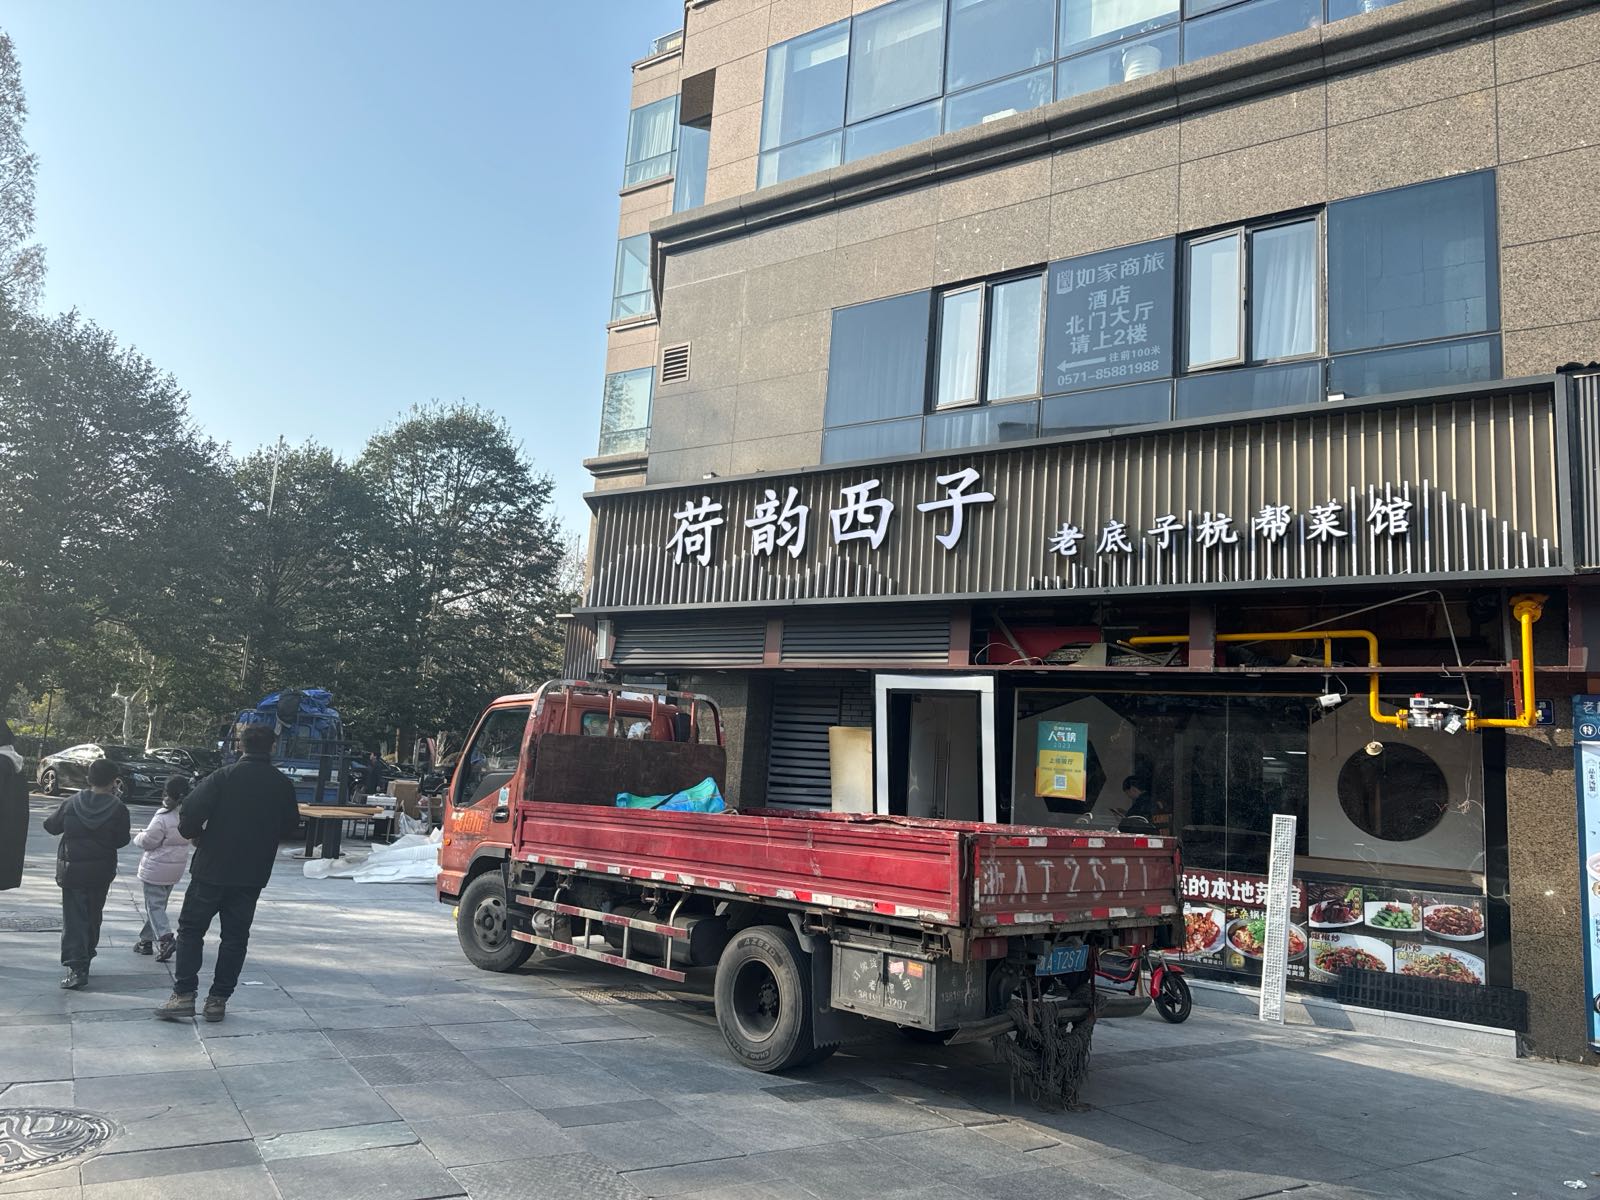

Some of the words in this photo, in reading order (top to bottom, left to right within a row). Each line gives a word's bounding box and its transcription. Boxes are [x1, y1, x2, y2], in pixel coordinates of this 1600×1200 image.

[1076, 252, 1165, 288] 如家商旅
[1088, 285, 1131, 310] 酒店
[1065, 301, 1154, 335] 北门大厅
[1070, 323, 1148, 354] 请上2楼
[1109, 345, 1161, 363] 往前100米
[1057, 360, 1160, 386] 0571-85881988
[667, 467, 995, 566] 荷韵西子
[1048, 497, 1413, 555] 老底子杭帮菜馆
